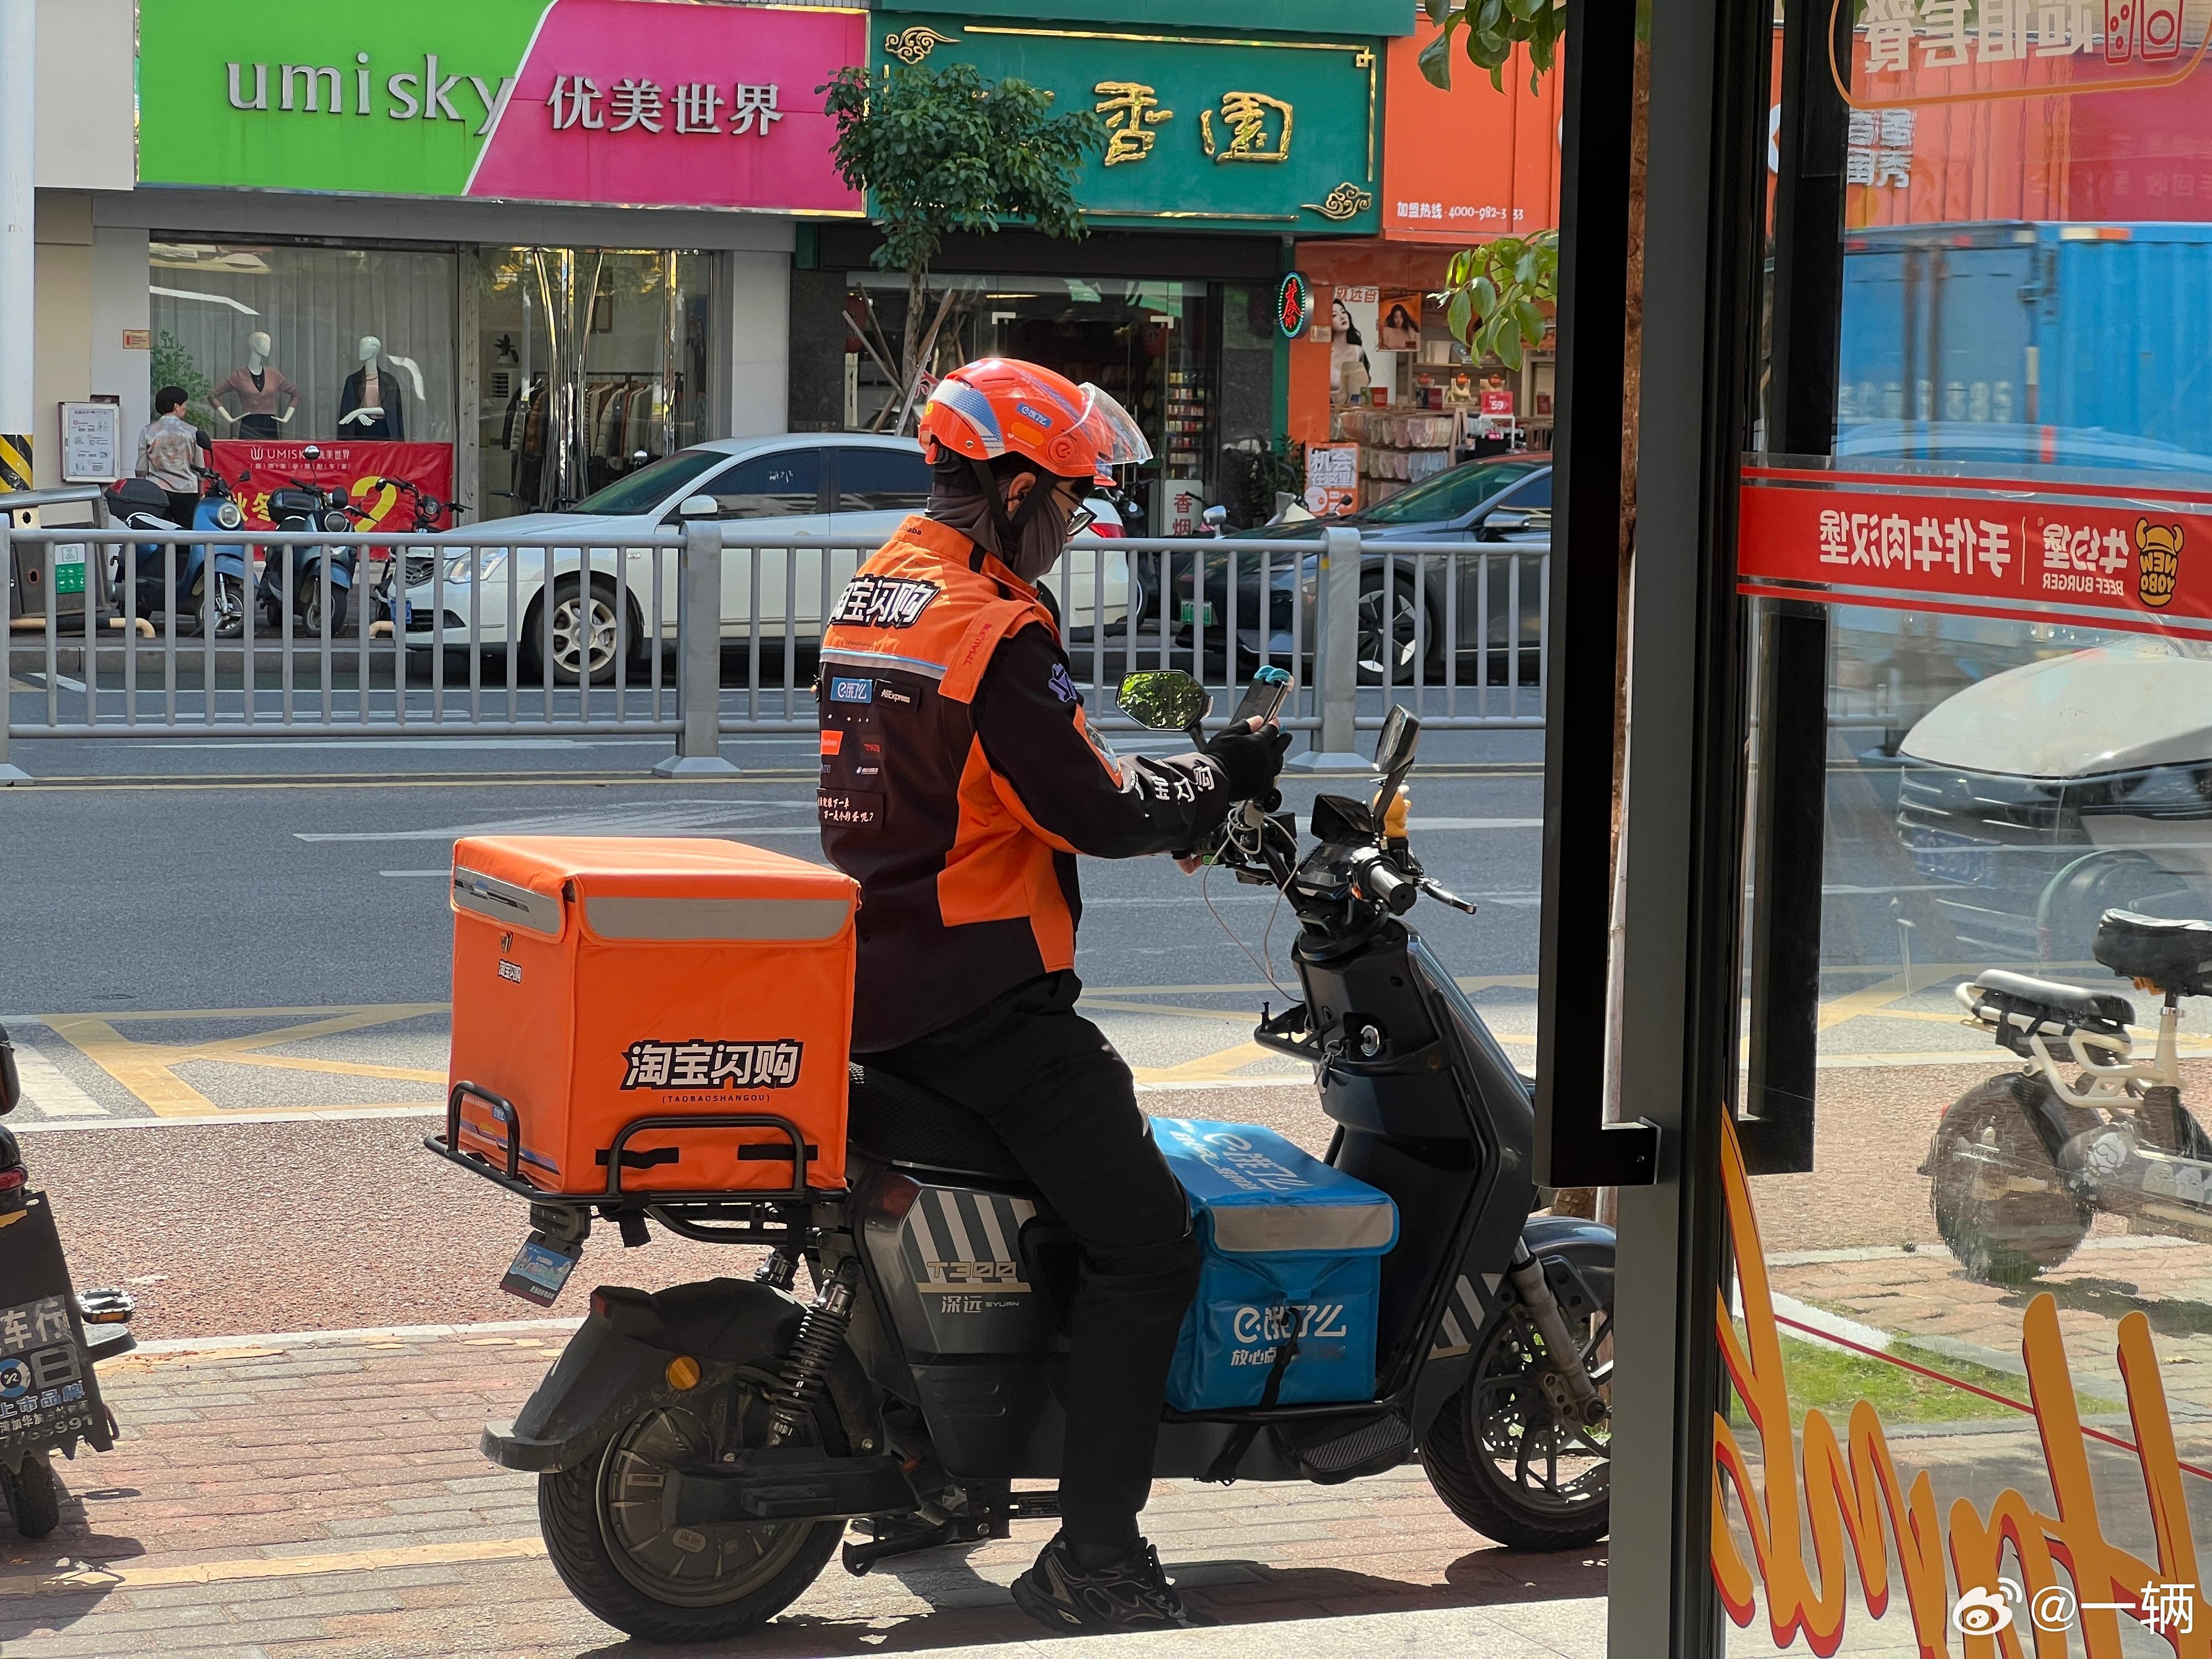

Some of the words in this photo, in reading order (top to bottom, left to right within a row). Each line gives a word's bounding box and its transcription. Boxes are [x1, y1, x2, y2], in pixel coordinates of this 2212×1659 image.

[548, 74, 784, 136] 优美世界
[267, 449, 306, 459] UMISK
[1311, 450, 1352, 472] 机会
[1311, 472, 1351, 486] 在这里
[1172, 493, 1193, 536] 香烟
[627, 1043, 799, 1087] 淘宝闪购
[927, 1261, 1017, 1278] T300
[941, 1295, 982, 1313] 深远
